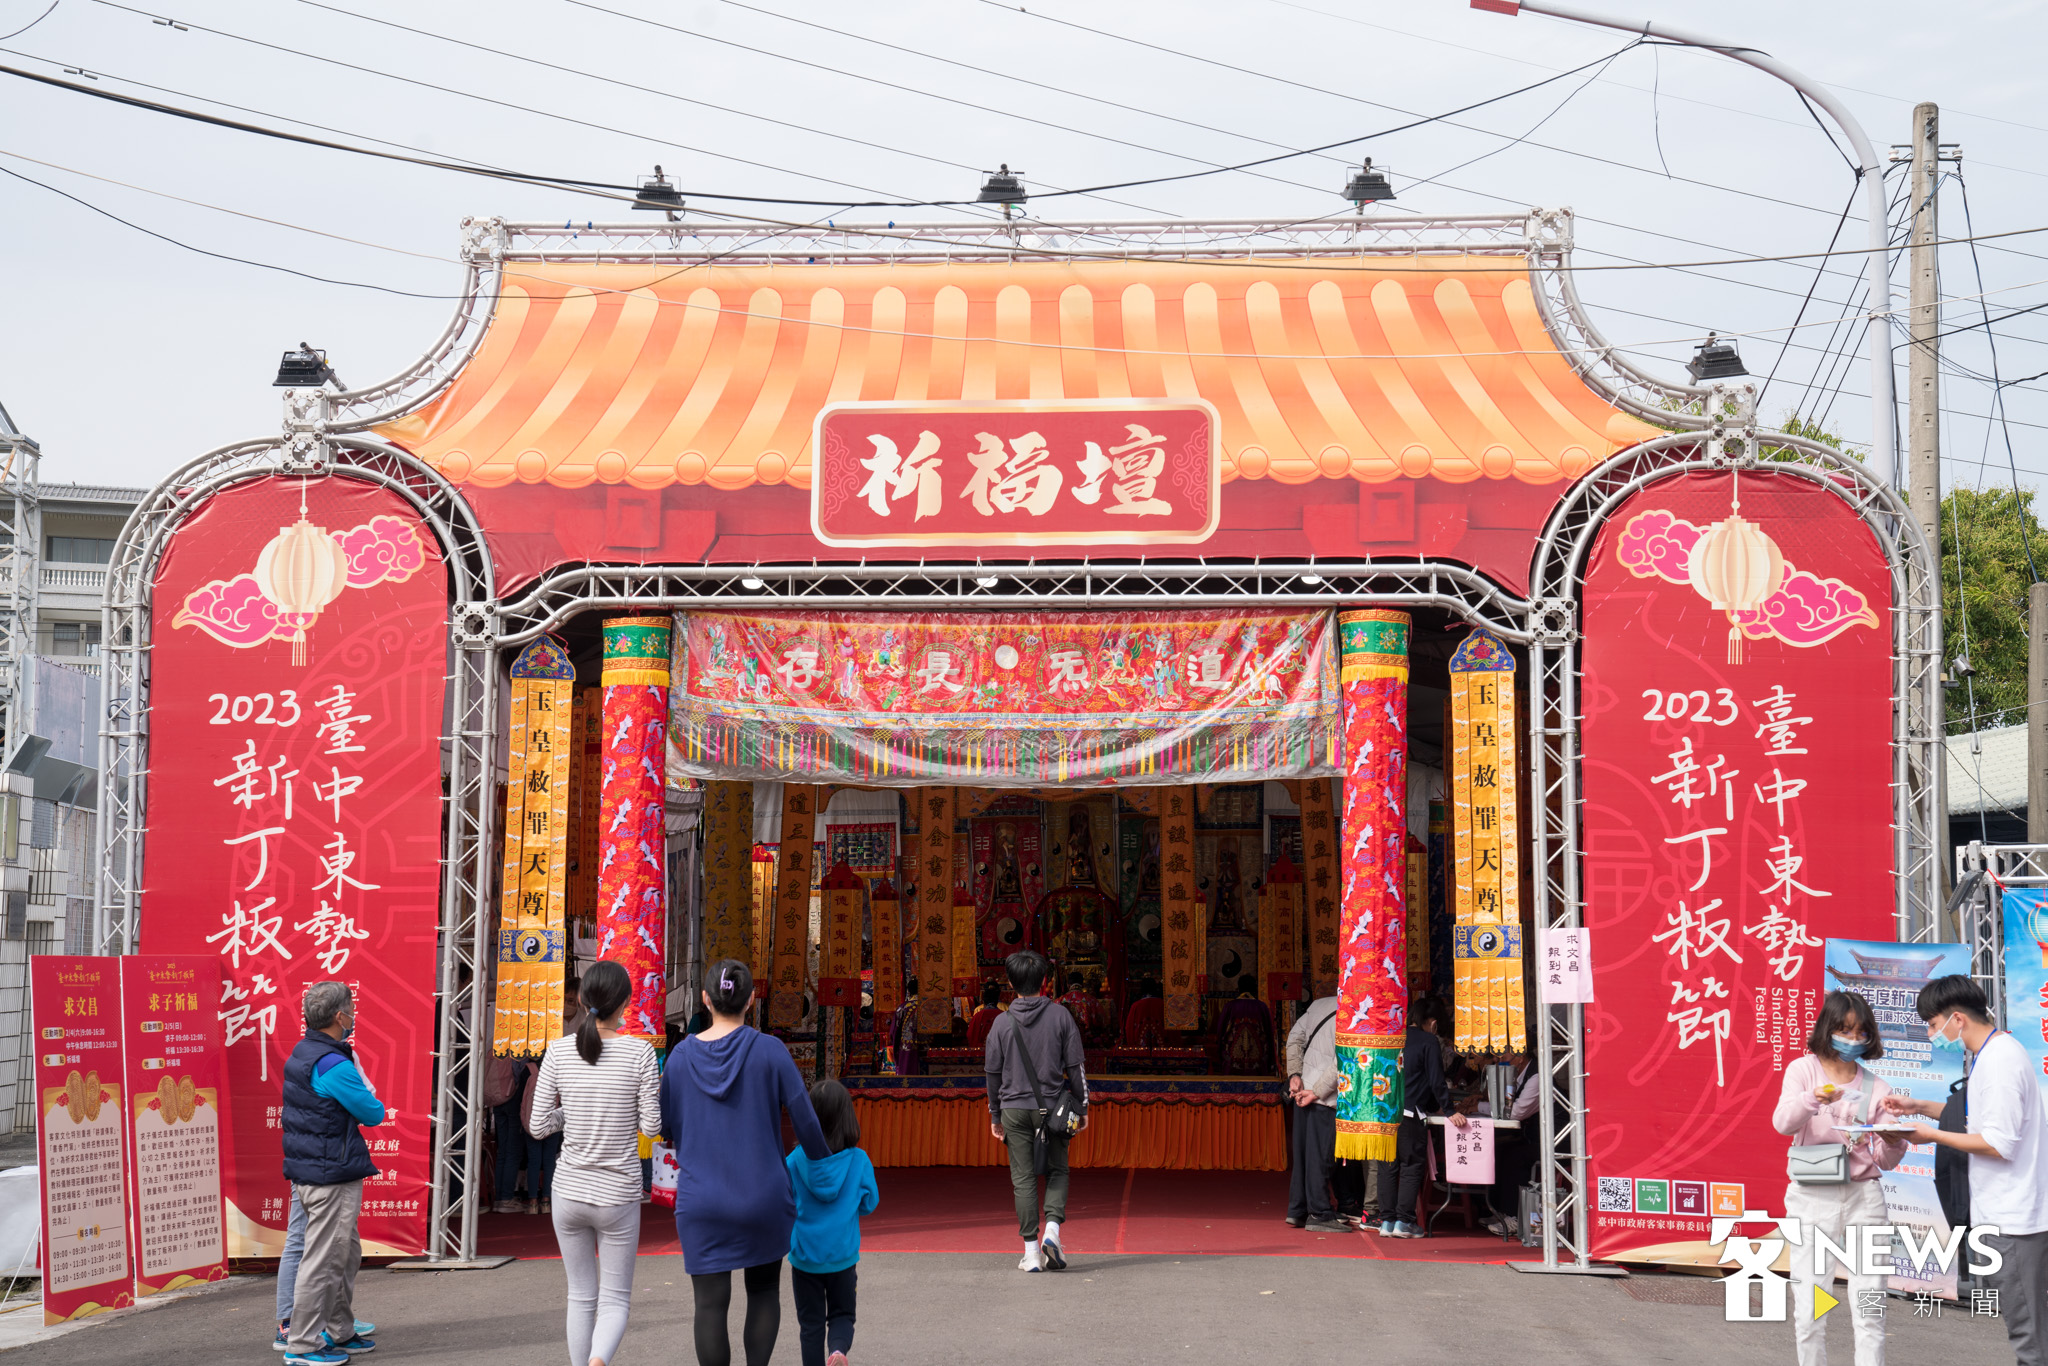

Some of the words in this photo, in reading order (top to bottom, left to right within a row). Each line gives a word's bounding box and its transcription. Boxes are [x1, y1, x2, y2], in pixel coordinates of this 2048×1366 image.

[857, 424, 1172, 522] 祈福壇
[208, 689, 302, 728] 2023
[1642, 688, 1739, 726] 2023
[294, 684, 381, 974] 臺中東勢
[521, 689, 553, 917] 玉皇赦罪天尊
[1471, 683, 1500, 914] 玉皇赦罪天尊
[1743, 685, 1832, 981] 臺中東勢
[925, 787, 949, 992] 寶金書功德浩大
[1567, 934, 1579, 972] 求文昌
[64, 997, 98, 1016] 求文昌
[149, 993, 198, 1012] 求子祈福
[1755, 987, 1768, 1043] Festival
[1770, 987, 1784, 1071] Sindingban
[1786, 988, 1801, 1050] DongShi
[1471, 1120, 1482, 1152] 求文昌
